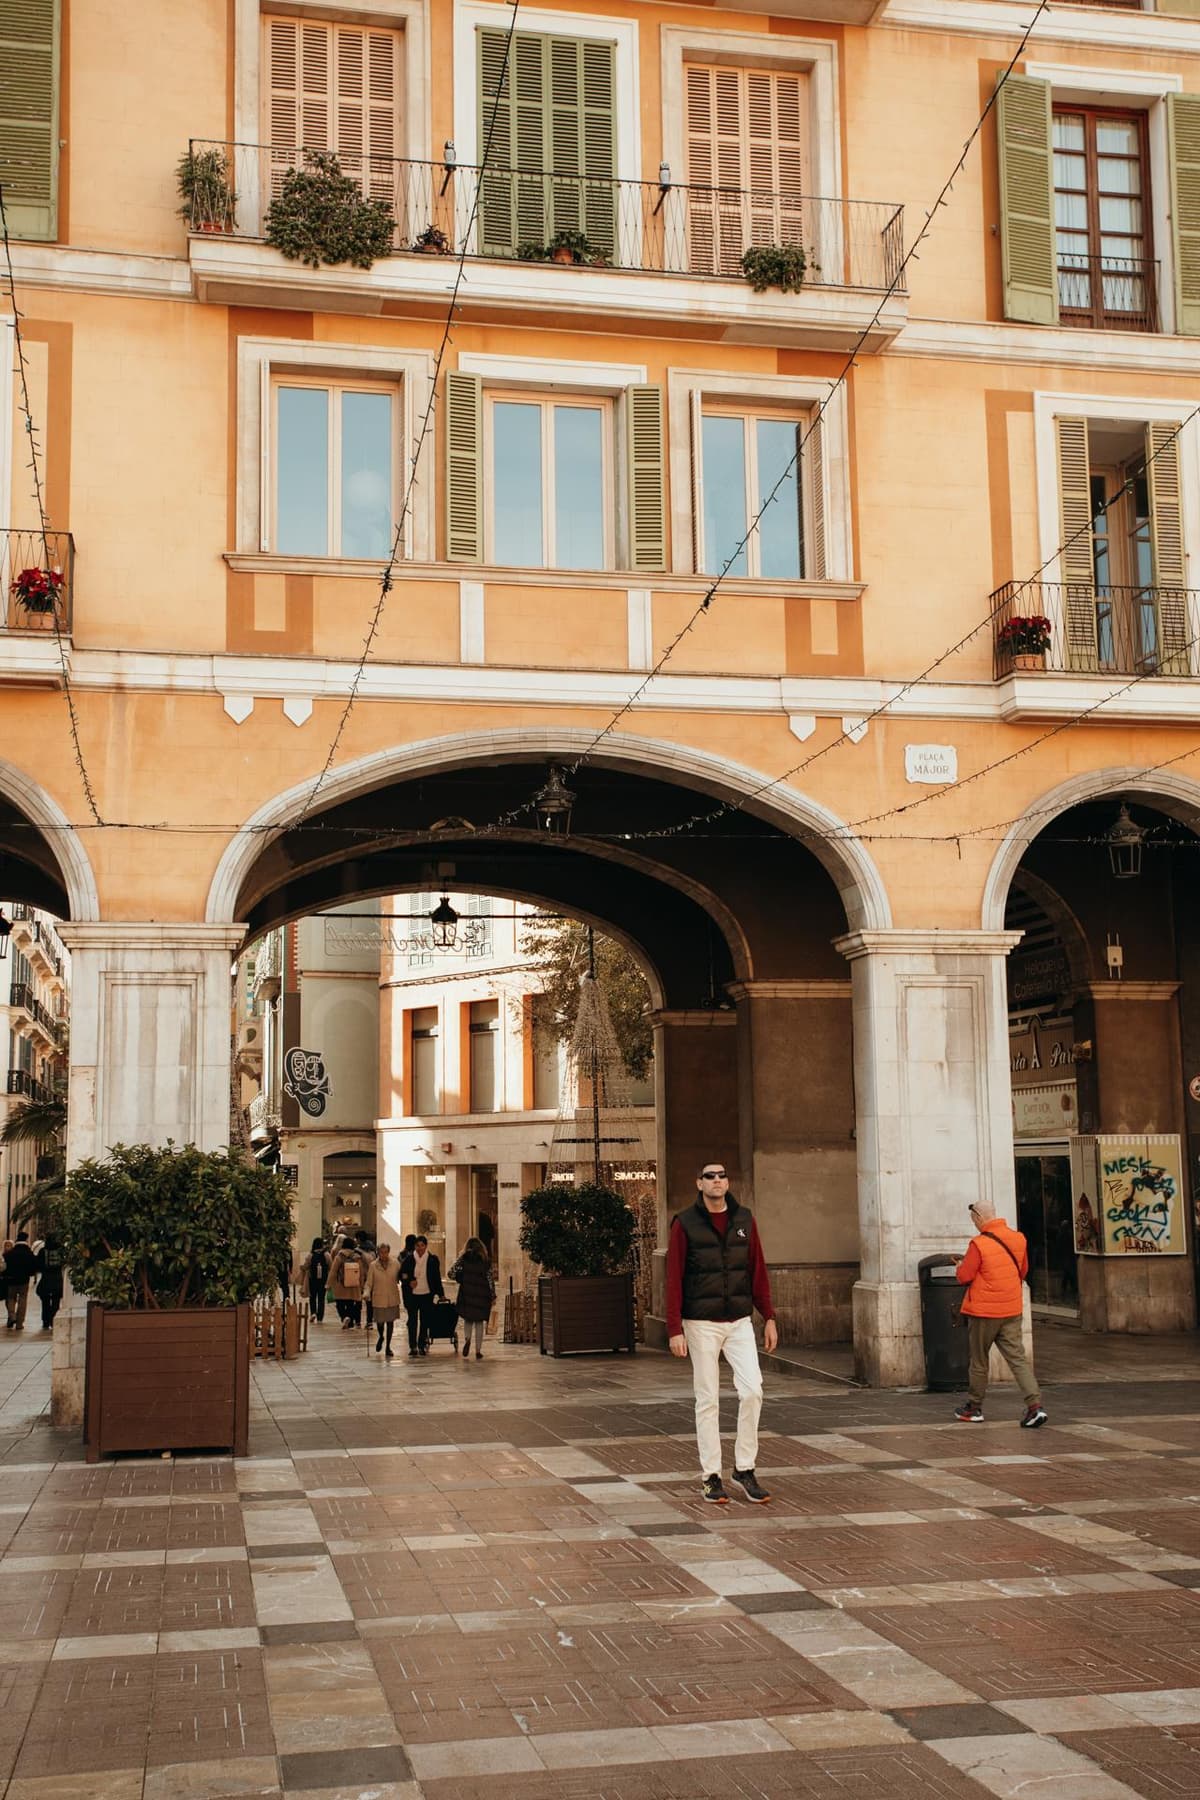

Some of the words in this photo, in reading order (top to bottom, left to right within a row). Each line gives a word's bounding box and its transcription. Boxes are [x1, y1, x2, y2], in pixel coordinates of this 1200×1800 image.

[918, 752, 944, 763] PLAÇA
[913, 765, 950, 775] MAJOR
[614, 1171, 657, 1181] SIMORRA
